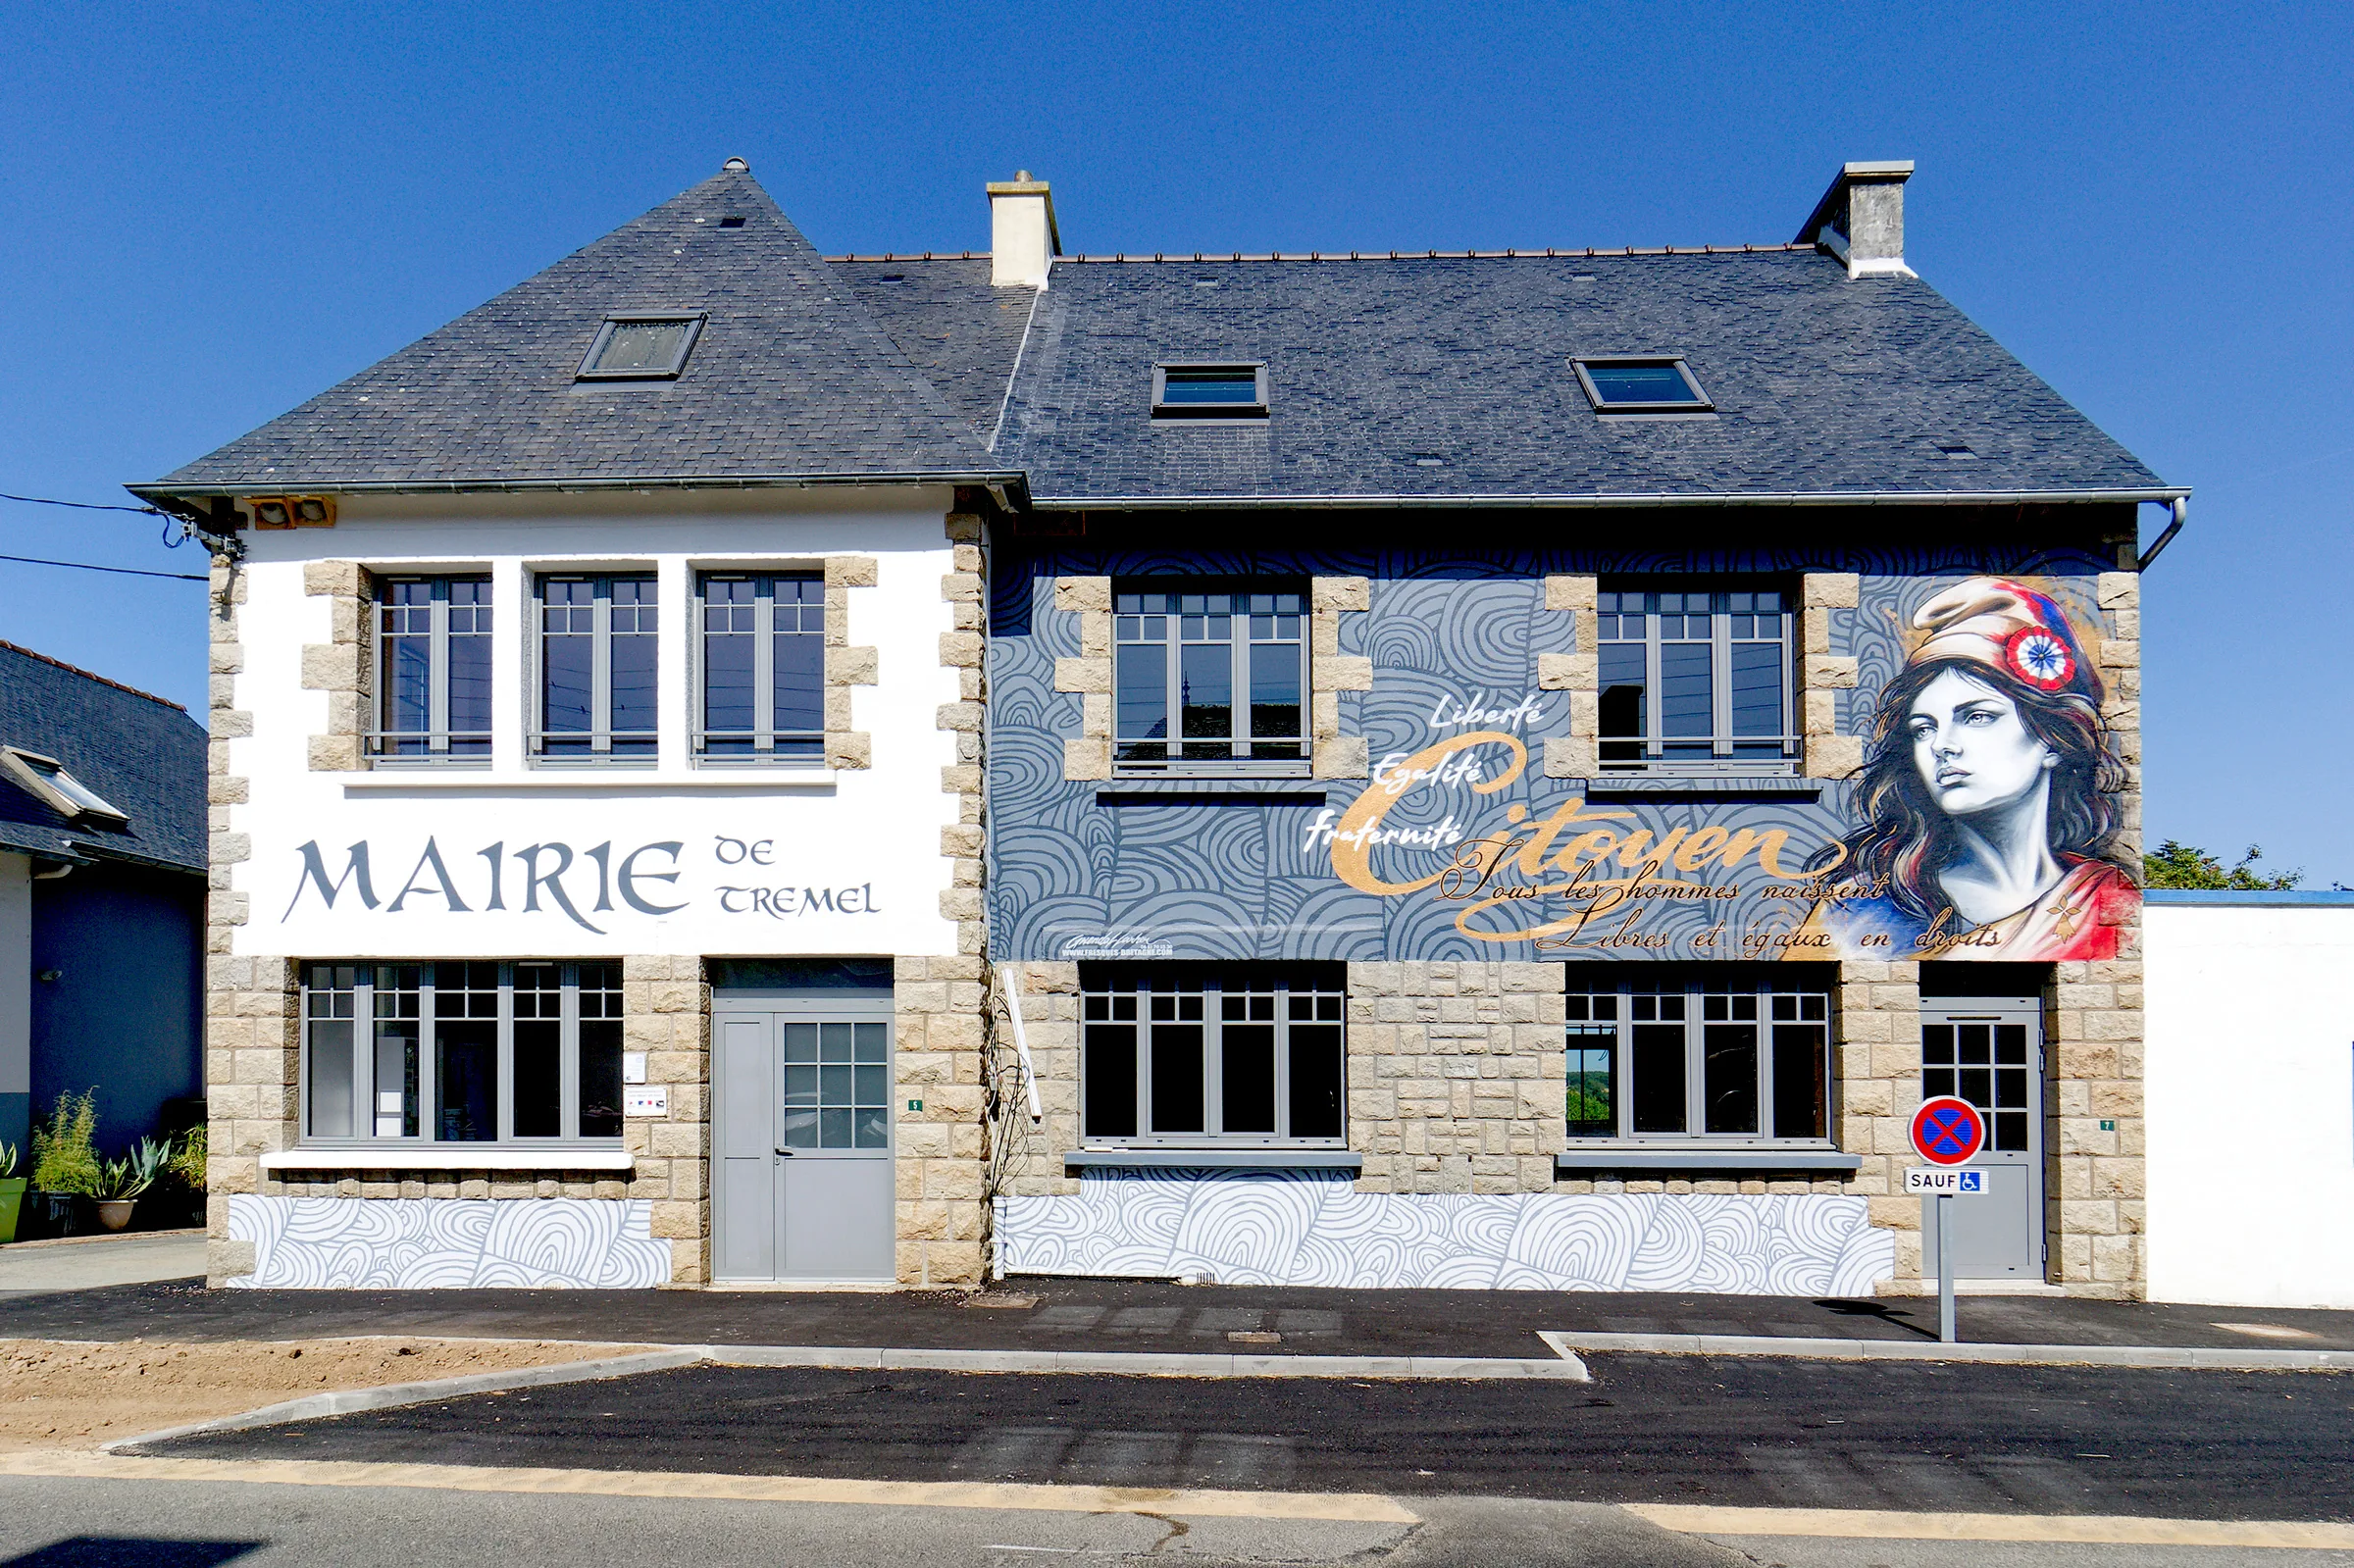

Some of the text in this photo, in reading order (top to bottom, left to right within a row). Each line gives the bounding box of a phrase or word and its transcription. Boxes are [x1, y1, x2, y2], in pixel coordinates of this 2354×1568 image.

[1430, 692, 1545, 730] Liberté
[1373, 750, 1484, 795] Egalité
[714, 835, 777, 865] DE
[1330, 731, 1848, 942] Citoyen
[281, 835, 691, 935] MAIRIE
[1433, 838, 1890, 900] Tous les hommes naissent
[714, 883, 882, 920] TREMEL
[1535, 886, 2003, 959] Libres et égaux en droits
[2104, 1121, 2111, 1130] 7
[1911, 1174, 1957, 1188] SAUF
